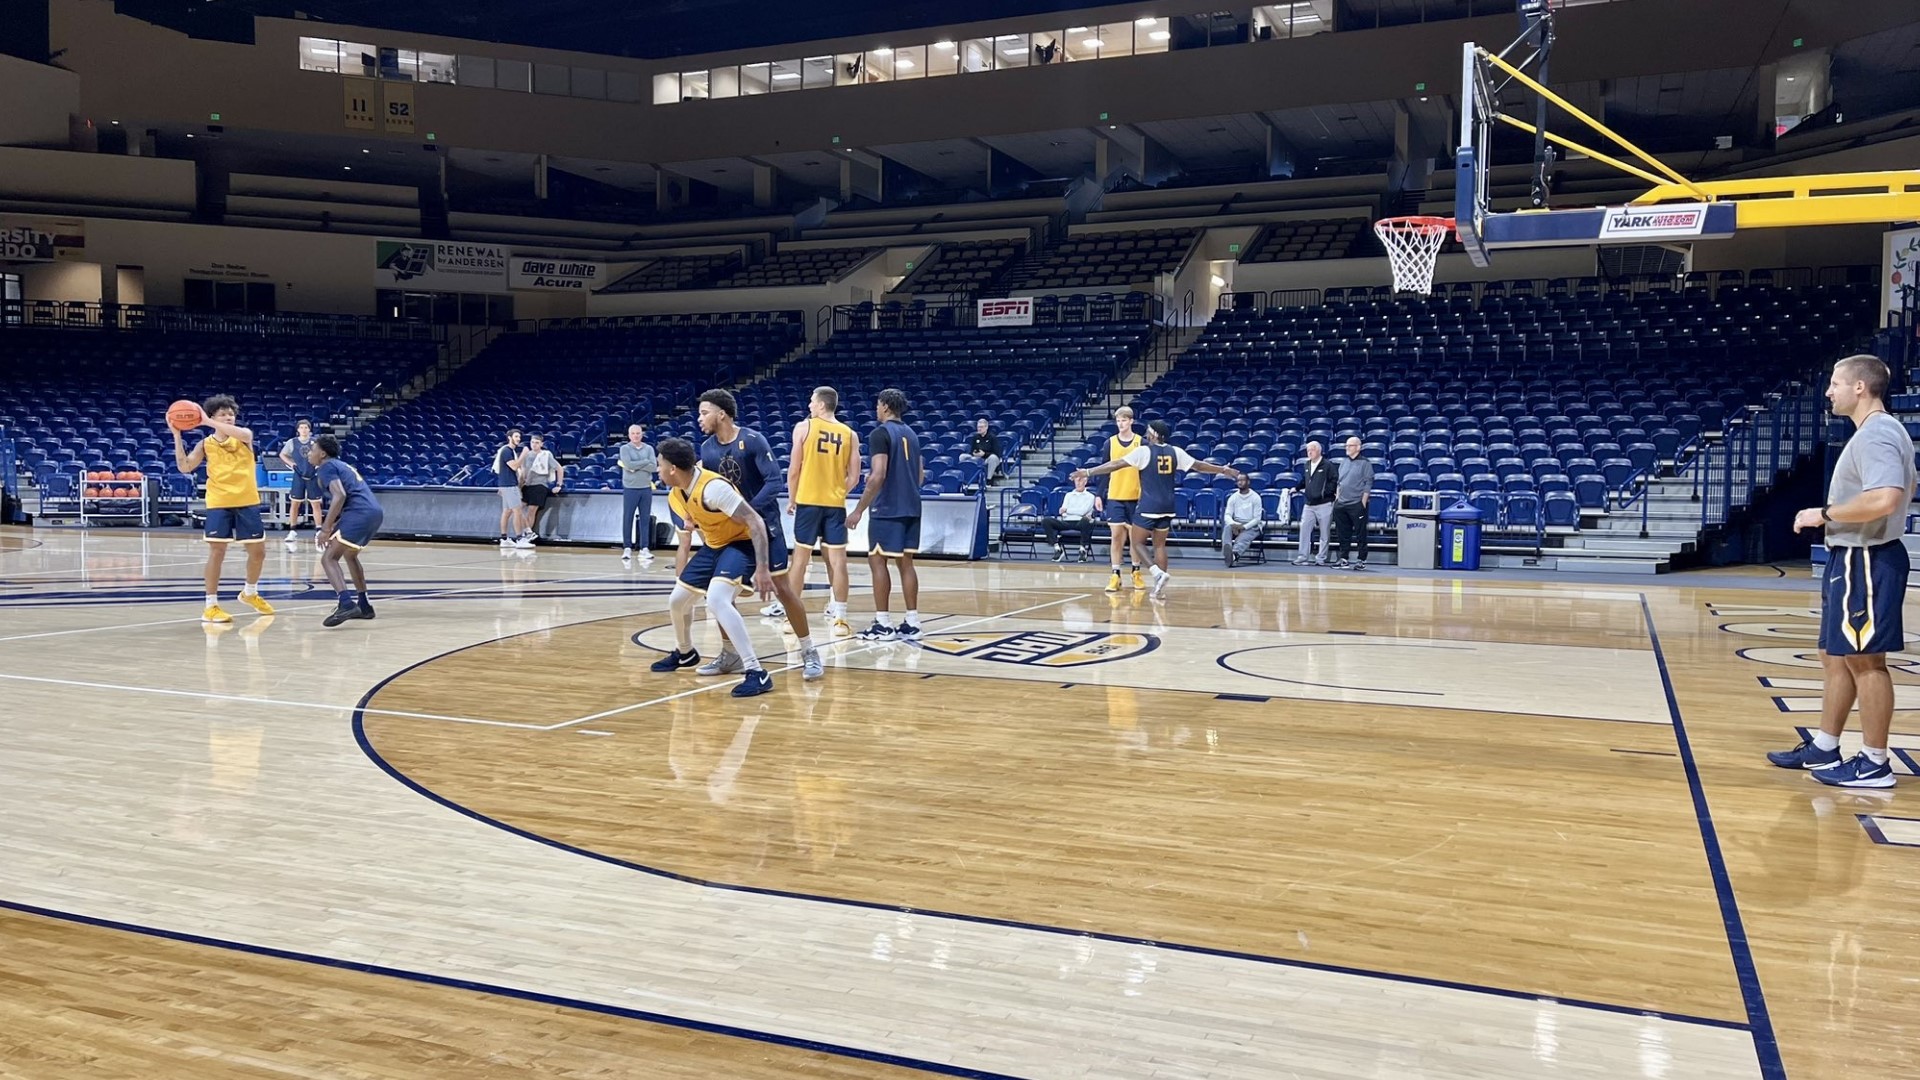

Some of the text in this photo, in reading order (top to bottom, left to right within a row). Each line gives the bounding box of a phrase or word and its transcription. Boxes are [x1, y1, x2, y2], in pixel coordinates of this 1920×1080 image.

[352, 98, 366, 112] 11
[389, 102, 409, 116] 52
[1613, 214, 1654, 228] YARK
[437, 244, 504, 259] RENEWAL
[437, 257, 504, 268] by ANDERSEN
[522, 260, 596, 277] dave white
[533, 276, 583, 288] Acura
[982, 301, 1029, 316] ESPN
[817, 430, 842, 455] 24
[902, 437, 909, 461] 1
[1157, 455, 1173, 475] 23
